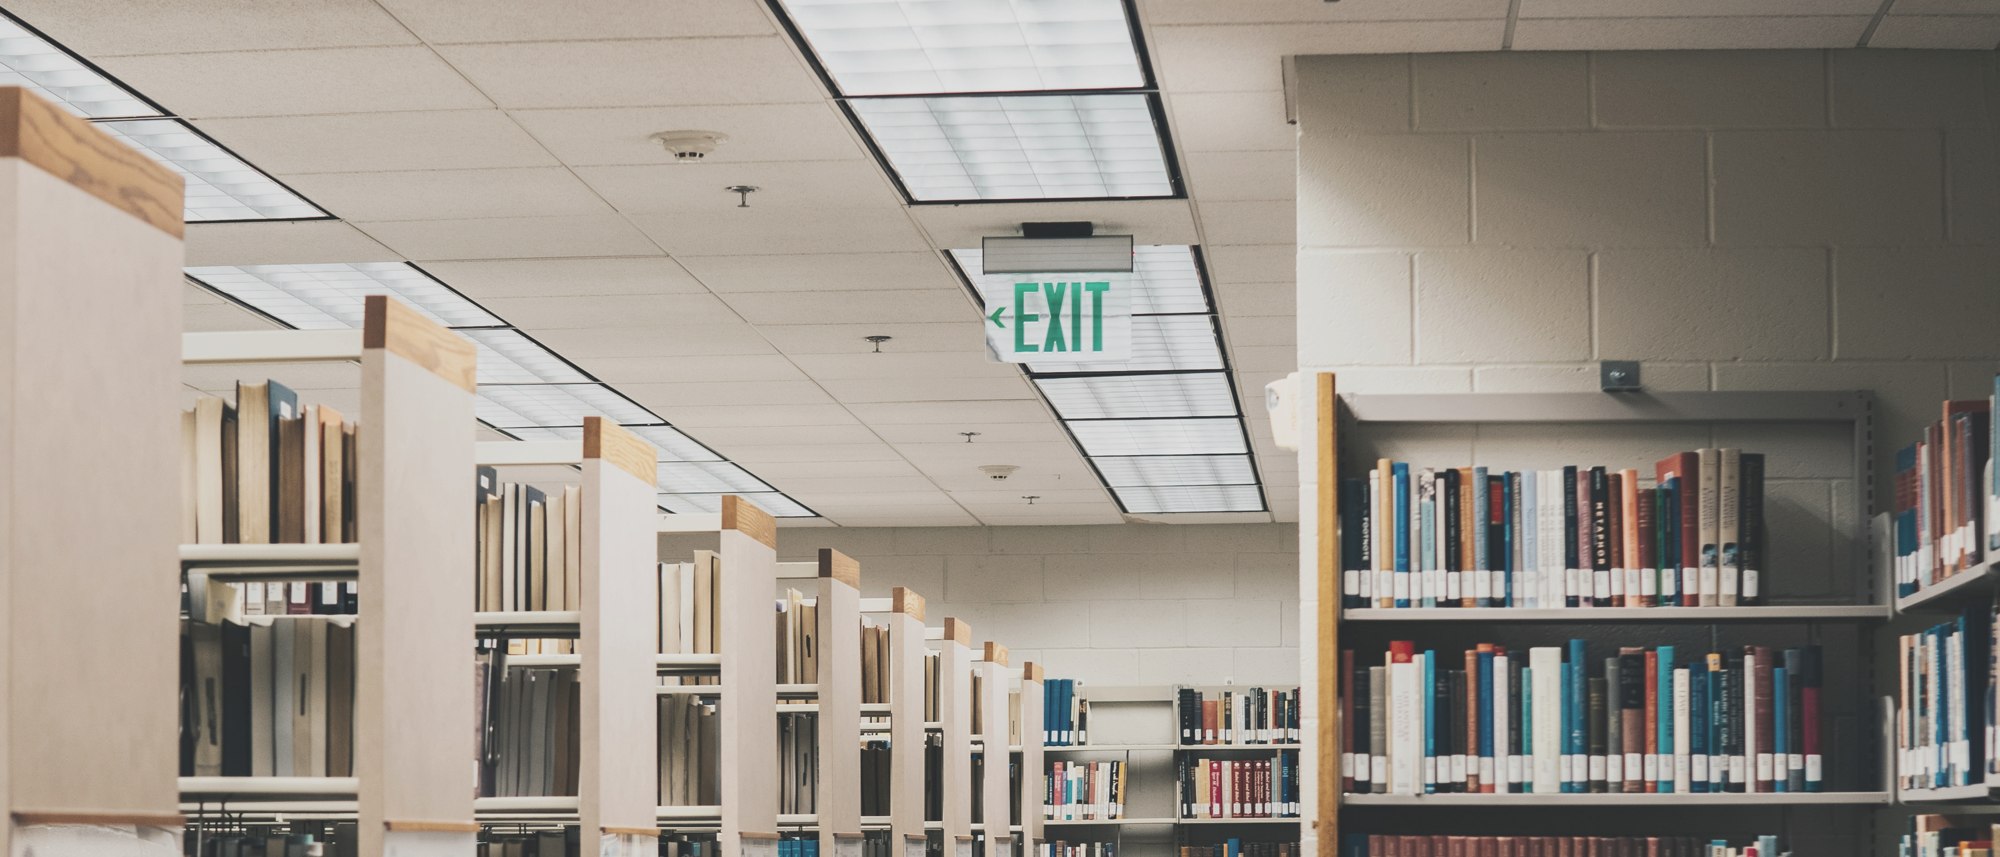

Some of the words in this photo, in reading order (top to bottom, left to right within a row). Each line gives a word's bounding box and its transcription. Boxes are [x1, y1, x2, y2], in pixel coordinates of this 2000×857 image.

[1014, 282, 1109, 352] EXIT
[1361, 517, 1369, 561] FOOTNOTE
[1595, 501, 1605, 565] METAPHOR
[1720, 674, 1729, 687] THE
[1720, 690, 1728, 712] MARK
[1720, 714, 1728, 724] OF
